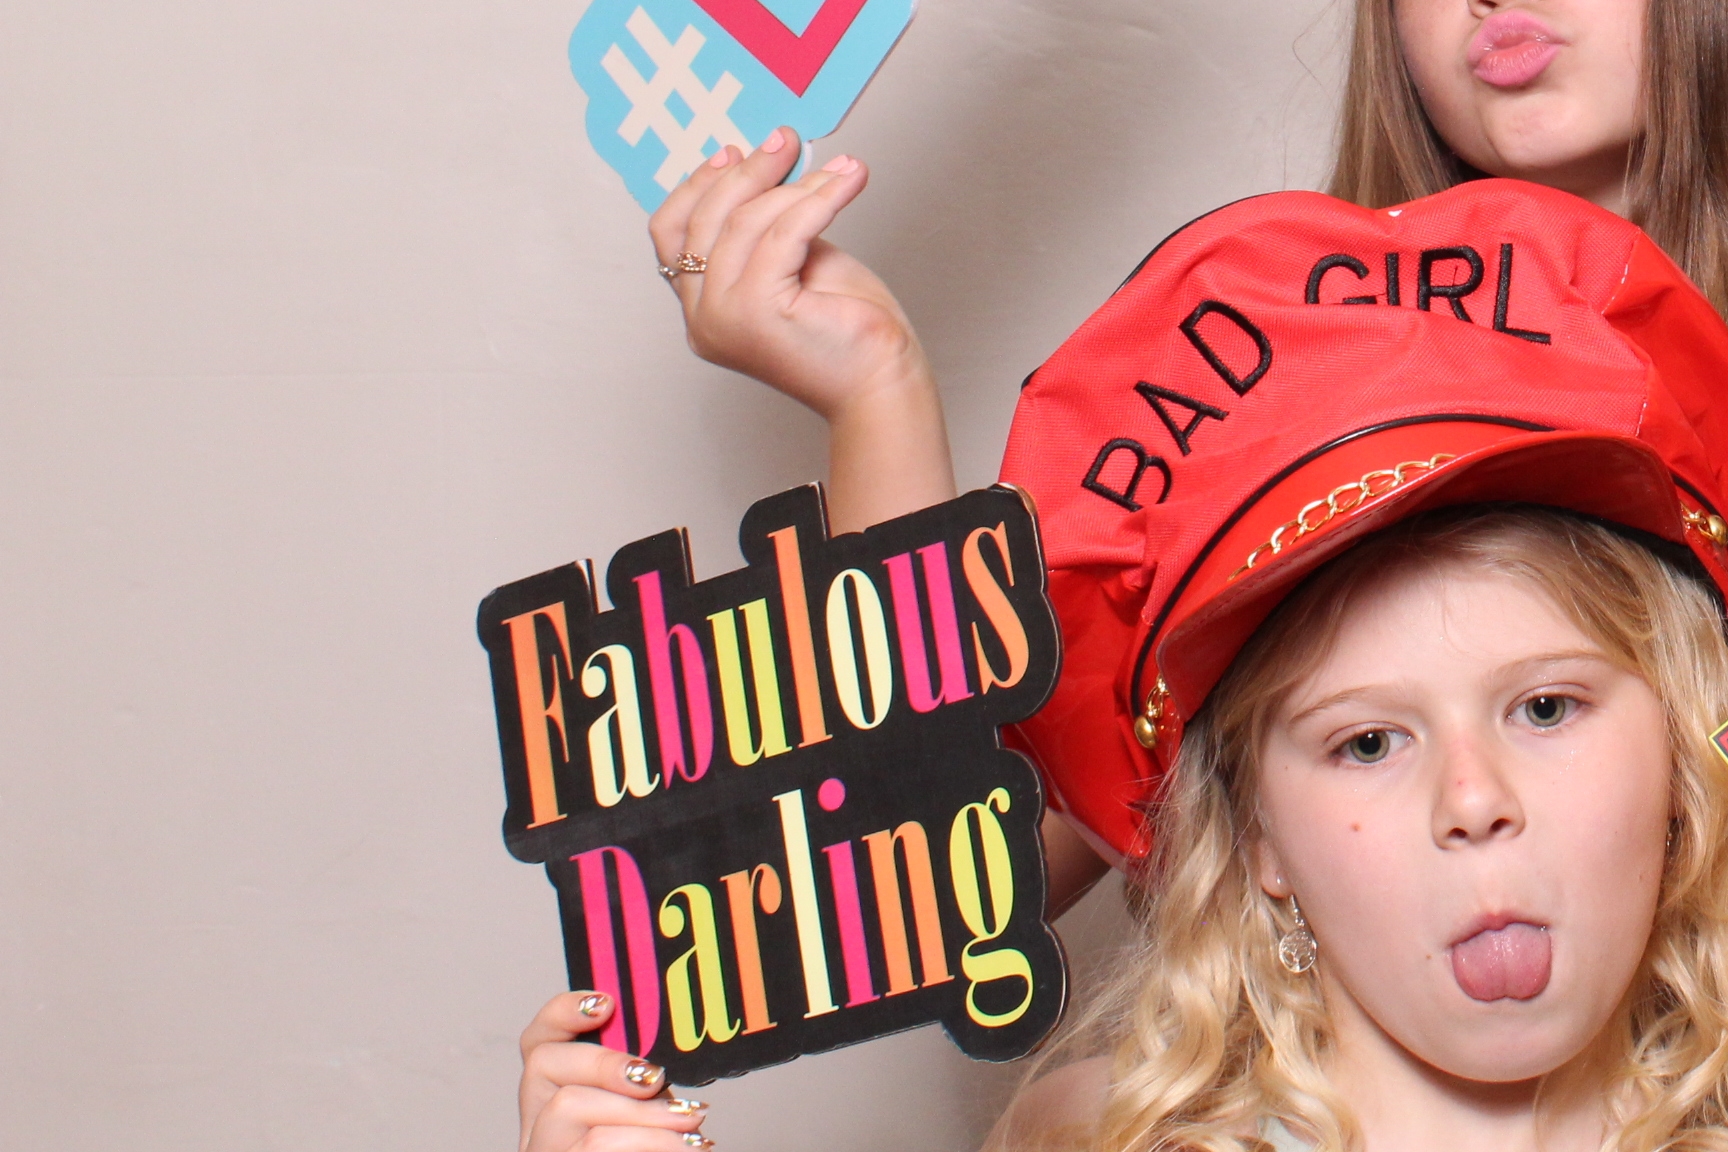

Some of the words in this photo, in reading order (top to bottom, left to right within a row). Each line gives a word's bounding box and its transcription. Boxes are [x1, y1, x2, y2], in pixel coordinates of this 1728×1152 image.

[1080, 299, 1273, 513] BAD
[1304, 243, 1552, 346] GIRL
[501, 520, 1030, 829] Fabulous
[568, 777, 1034, 1061] Darling
